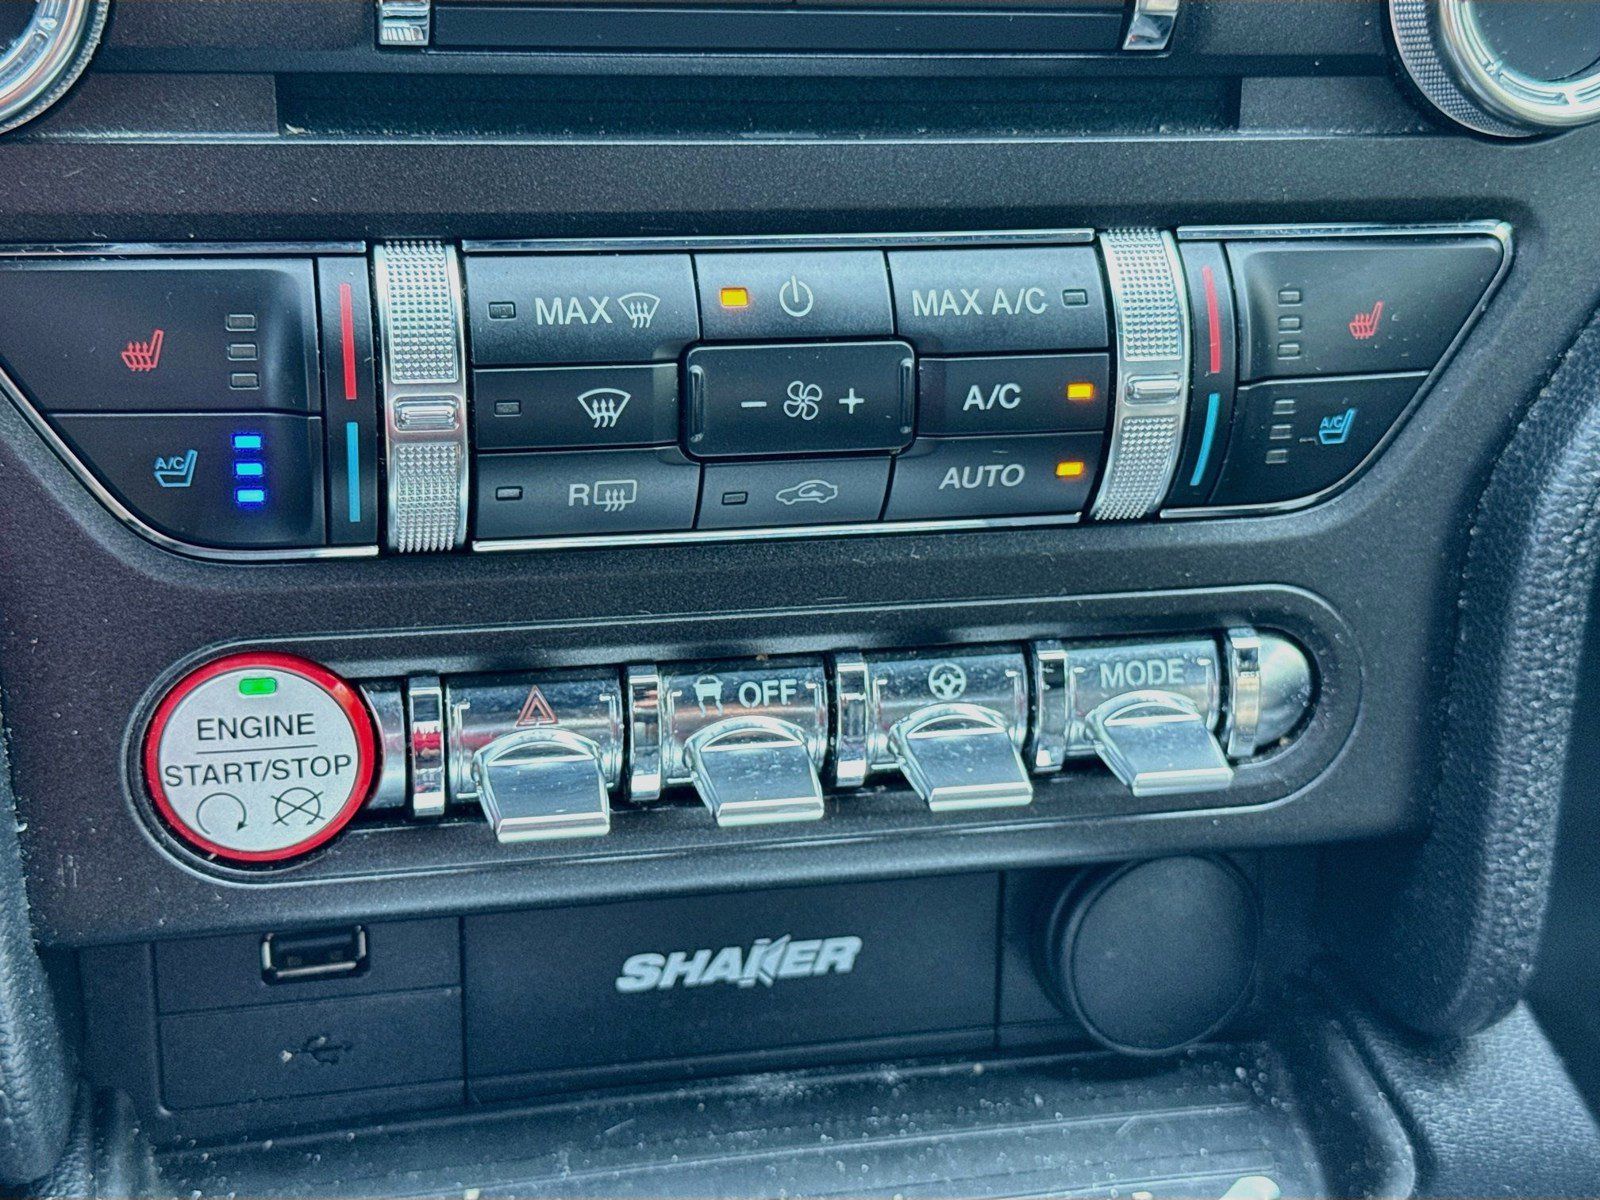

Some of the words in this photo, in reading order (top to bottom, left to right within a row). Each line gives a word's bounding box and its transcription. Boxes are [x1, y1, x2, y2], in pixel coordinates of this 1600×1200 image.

[534, 296, 613, 325] MAX
[911, 288, 983, 317] MAX
[991, 286, 1049, 316] A/C
[962, 382, 1022, 412] A/C
[153, 455, 186, 470] A/C
[938, 463, 1026, 490] AUTO
[568, 483, 591, 507] R
[1100, 657, 1185, 689] MODE
[738, 678, 798, 709] OFF
[196, 713, 316, 741] ENGINE
[164, 754, 352, 788] START/STOP
[615, 933, 863, 993] SHAKER
